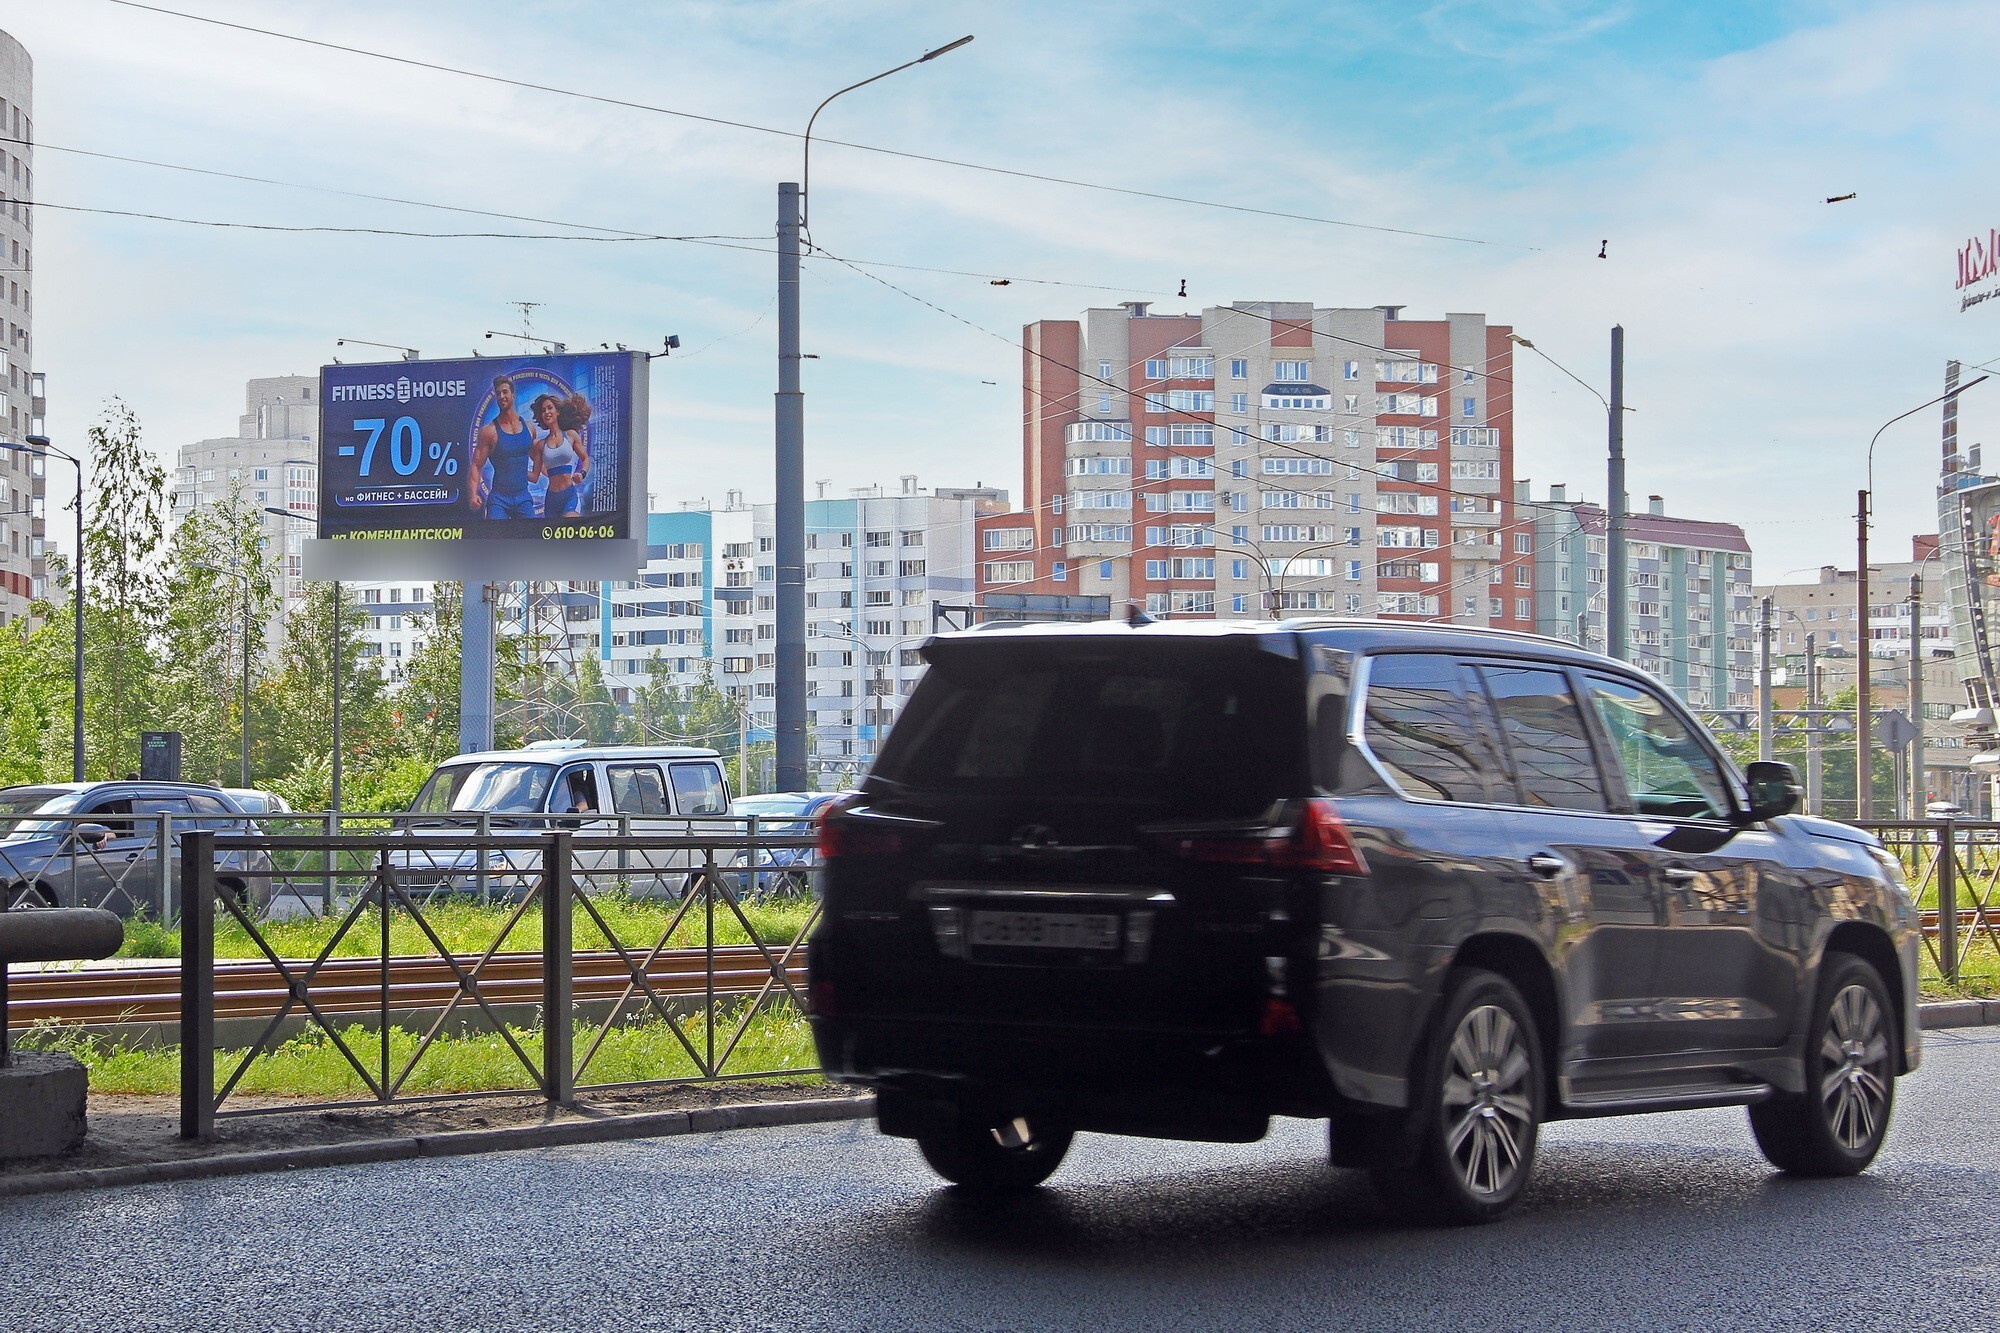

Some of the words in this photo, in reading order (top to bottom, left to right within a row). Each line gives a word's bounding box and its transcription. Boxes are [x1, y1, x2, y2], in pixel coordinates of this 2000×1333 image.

[332, 383, 395, 401] FITNESS
[413, 380, 466, 397] HOUSE
[356, 491, 395, 502] ФИТНЕС
[404, 488, 448, 500] БАССЕЙН
